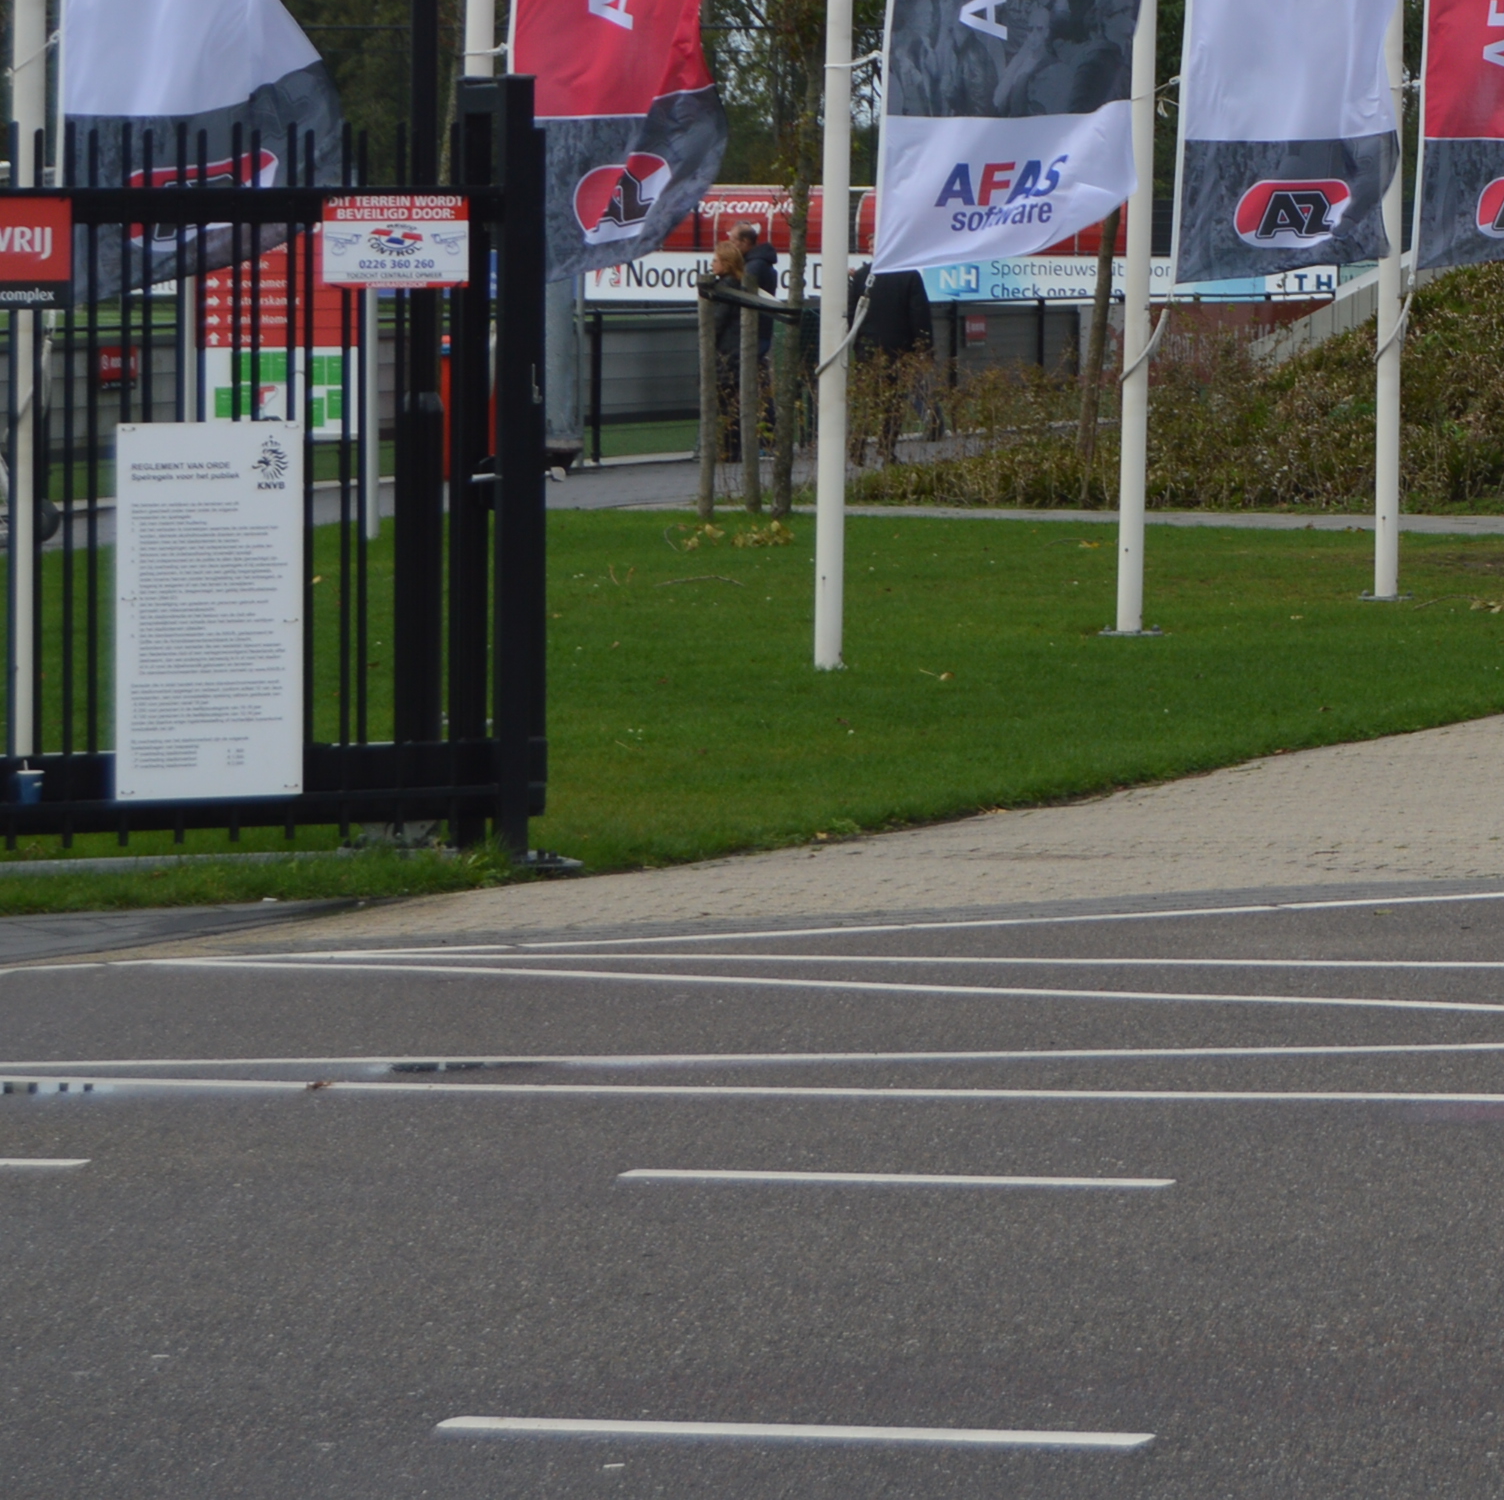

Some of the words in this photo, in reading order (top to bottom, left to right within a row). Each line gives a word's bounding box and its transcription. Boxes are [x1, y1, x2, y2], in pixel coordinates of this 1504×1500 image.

[935, 153, 1069, 207] AFAS
[355, 195, 411, 207] TERREIN
[414, 195, 463, 207] WORDT
[336, 208, 408, 220] BEVEILIGD
[412, 208, 456, 220] DOOR:
[951, 198, 1053, 233] software
[1255, 190, 1335, 239] AZ
[367, 236, 423, 257] CONTROL
[358, 258, 387, 269] 0226
[391, 258, 411, 269] 360
[414, 258, 435, 269] 260
[990, 260, 1096, 278] Sportnieuws
[940, 265, 978, 290] NH
[990, 284, 1041, 299] Check
[131, 462, 185, 471] REGLEMENT
[187, 462, 204, 470] VAN
[206, 461, 230, 470] ORDE
[257, 481, 286, 490] KNVB
